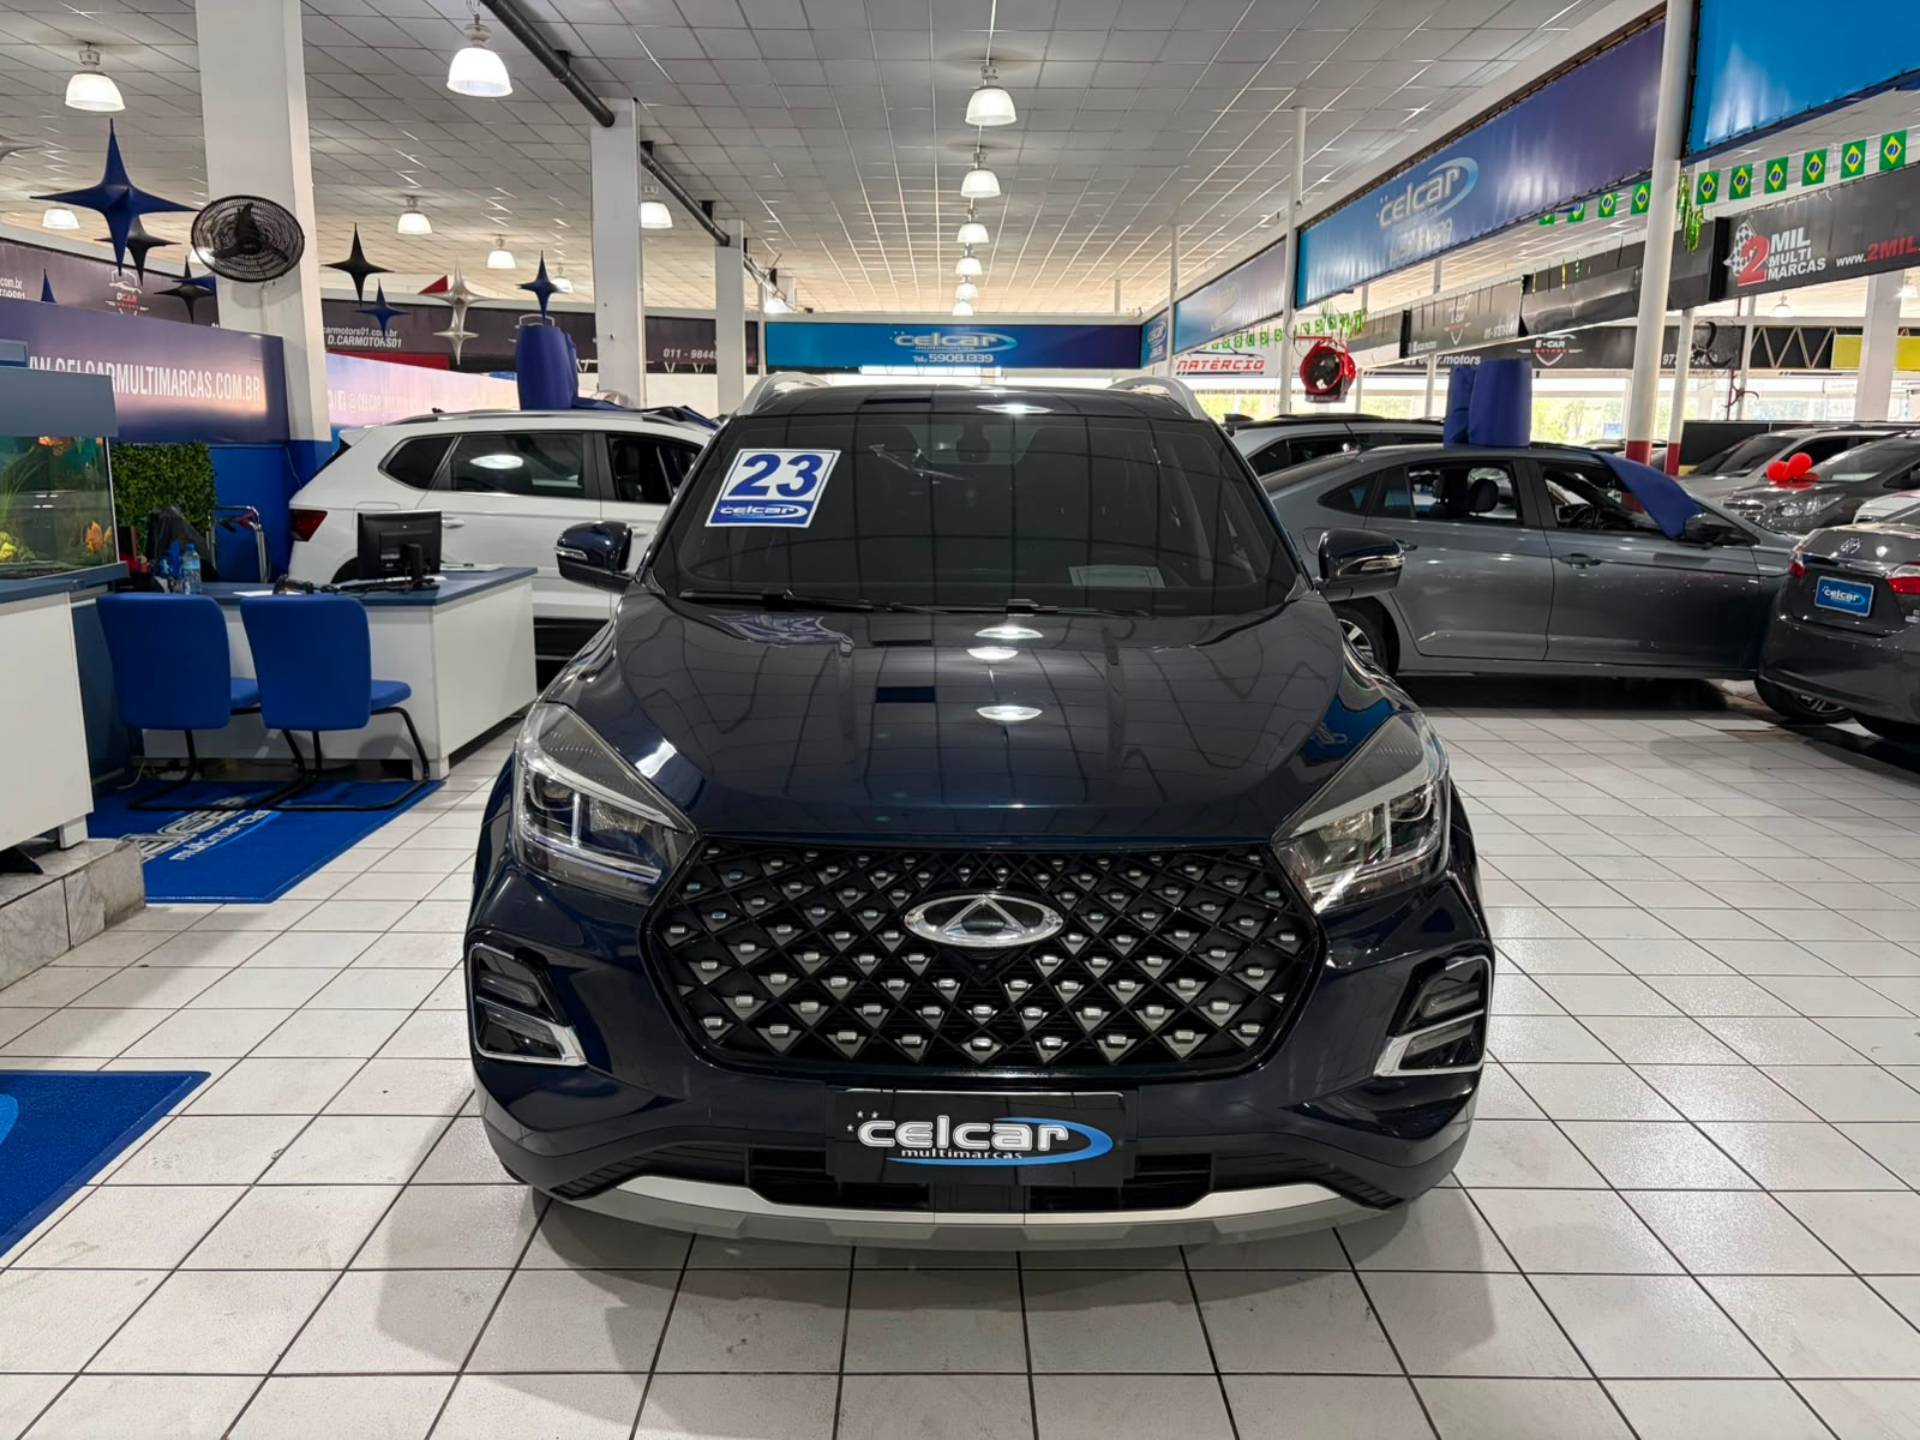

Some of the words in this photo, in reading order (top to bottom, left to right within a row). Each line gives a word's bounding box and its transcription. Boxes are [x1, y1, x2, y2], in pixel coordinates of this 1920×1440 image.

[1380, 168, 1460, 230] celcar
[1771, 227, 1811, 253] MIL
[1737, 235, 1770, 287] 2
[1768, 257, 1827, 282] MARCAS
[1769, 248, 1812, 268] MULTI
[895, 331, 998, 346] celcar
[729, 453, 823, 498] 23
[720, 505, 795, 515] celcar
[857, 1114, 1069, 1152] celcar
[901, 1147, 1023, 1160] multimarcas
